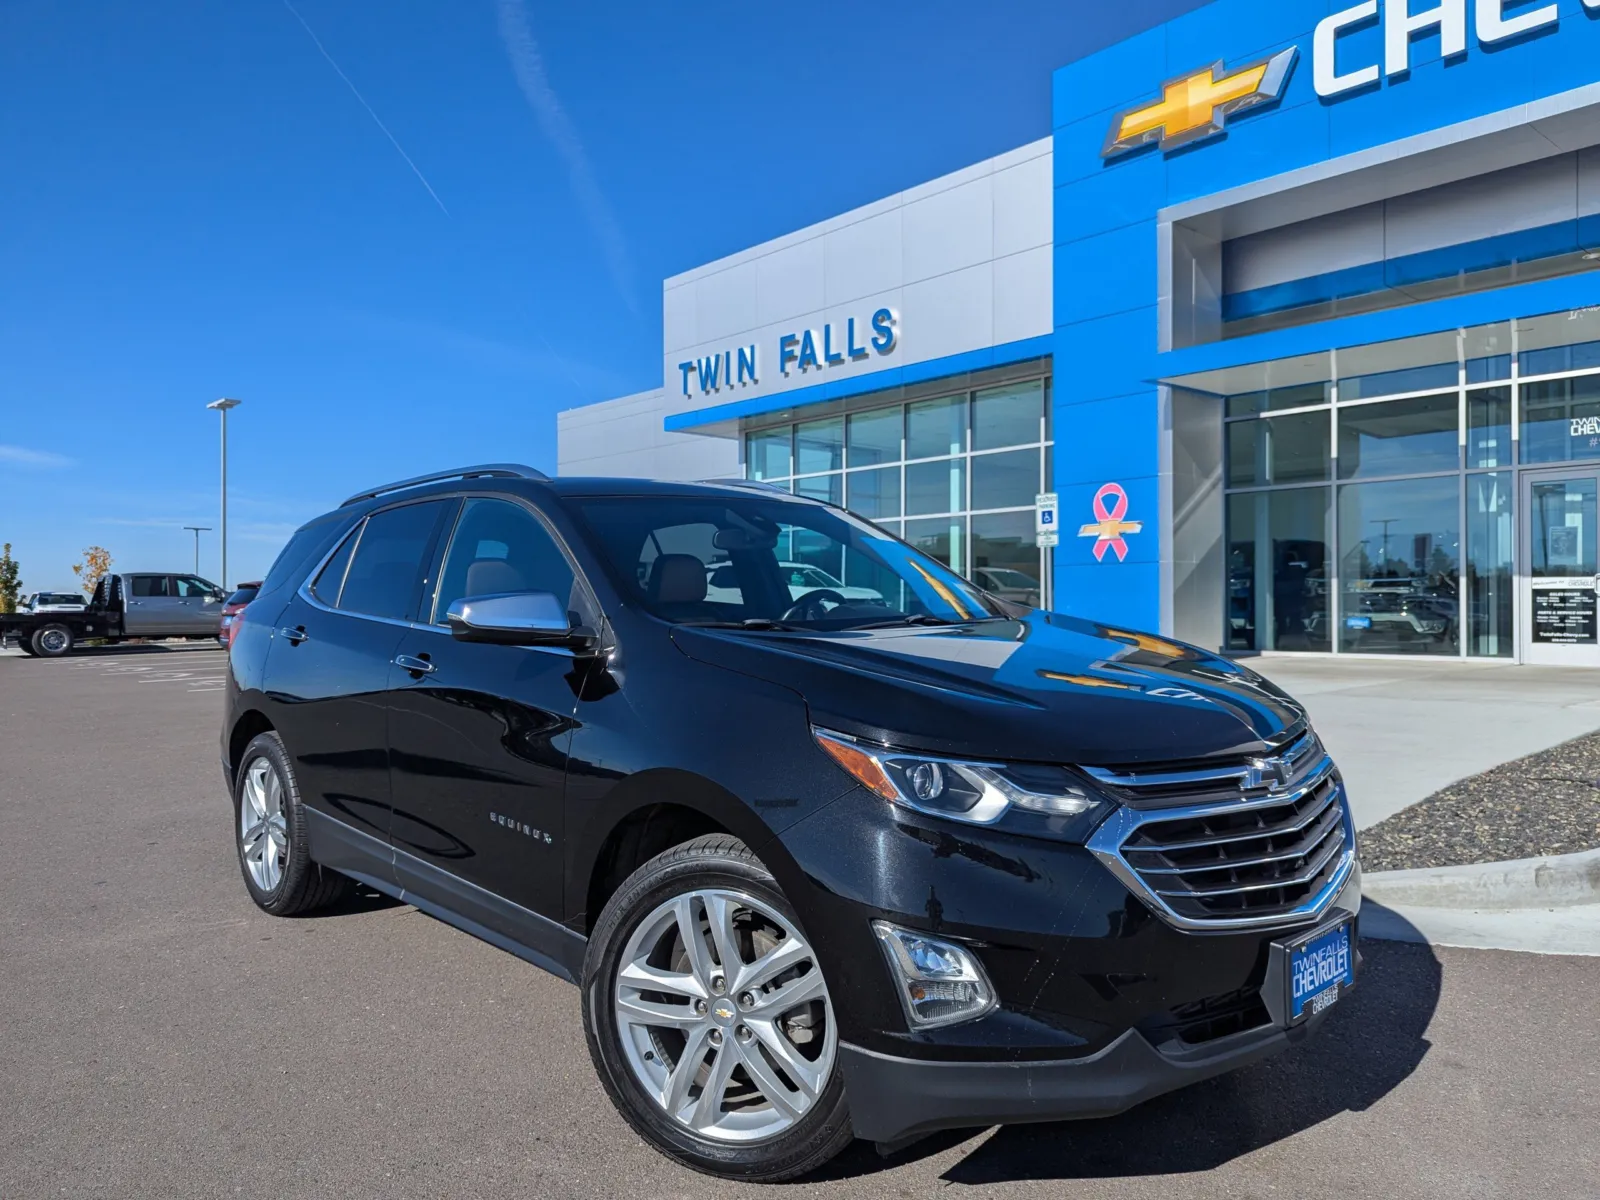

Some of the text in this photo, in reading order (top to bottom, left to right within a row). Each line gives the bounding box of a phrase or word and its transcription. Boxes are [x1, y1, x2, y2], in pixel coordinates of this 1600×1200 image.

[1313, 0, 1600, 97] CH
[678, 308, 896, 397] TWIN FALLS
[489, 811, 552, 844] EQUINOX
[1292, 948, 1349, 999] CHEVROLET
